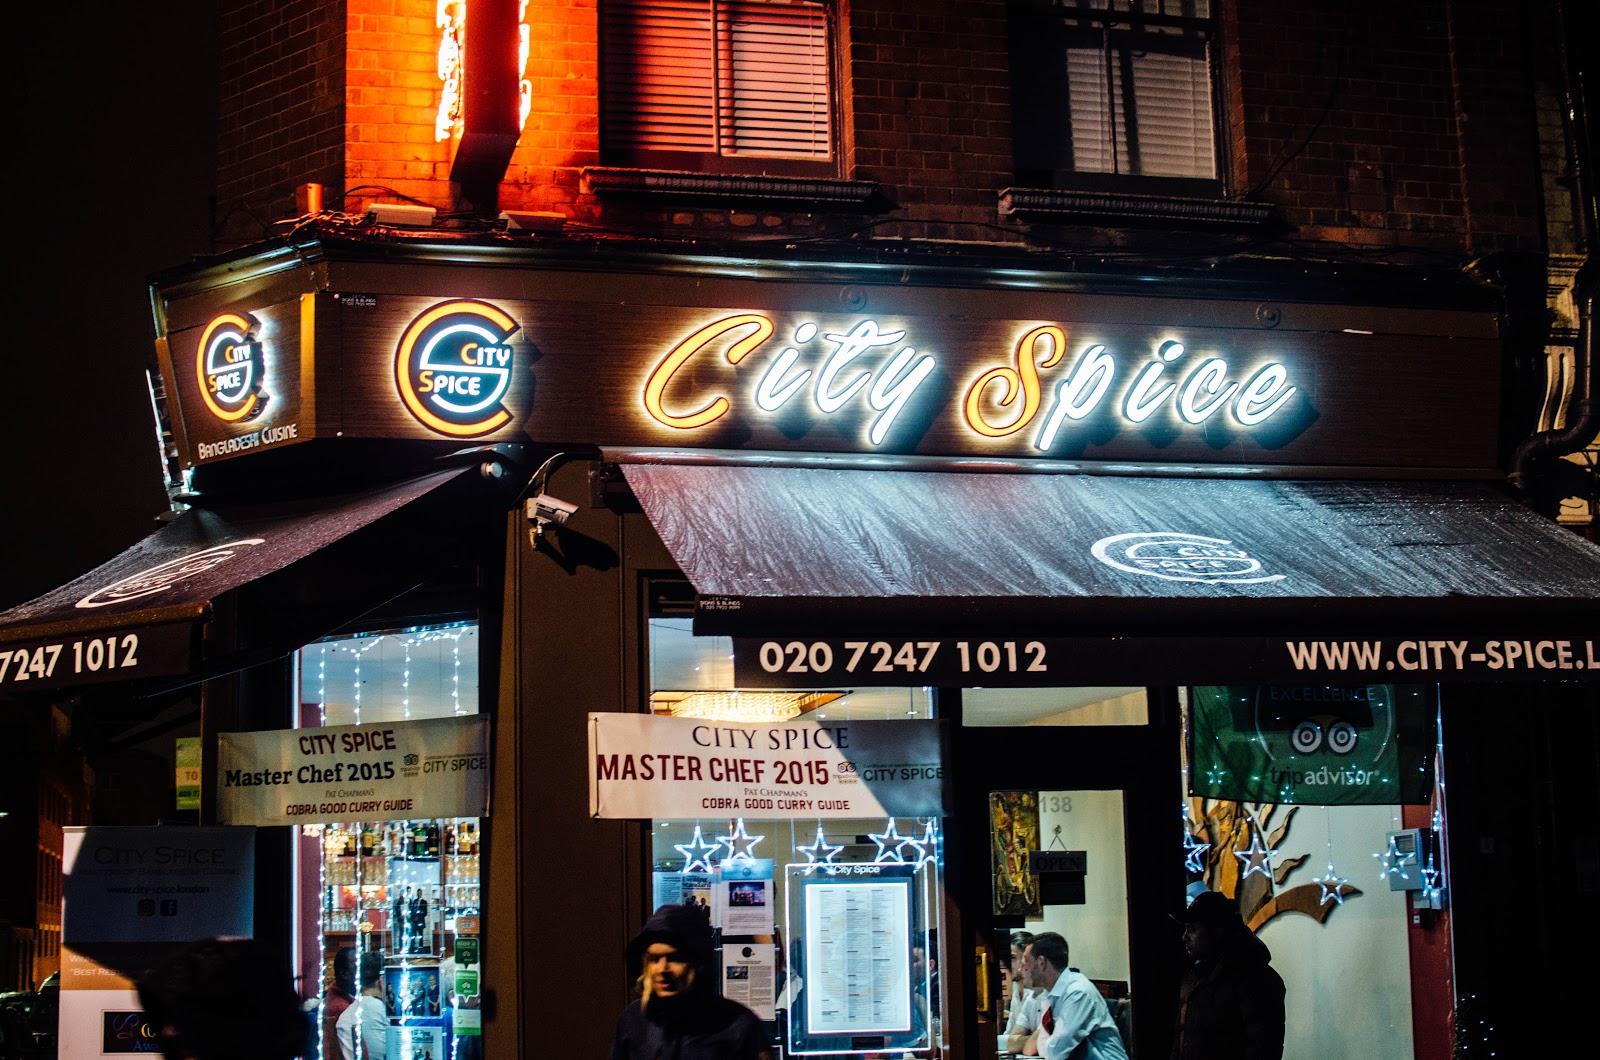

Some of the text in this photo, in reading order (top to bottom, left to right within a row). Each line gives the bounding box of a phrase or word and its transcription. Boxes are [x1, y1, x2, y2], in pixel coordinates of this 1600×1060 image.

[225, 344, 251, 363] CITY
[461, 342, 511, 367] CITY
[208, 371, 242, 393] SPICE
[418, 370, 482, 396] SPICE
[643, 312, 1297, 452] City Spice
[73, 633, 139, 674] 1012
[759, 641, 1048, 673] 020 7247 1012
[1269, 687, 1376, 702] EXCELLENCE
[299, 730, 396, 755] CITY SPICE
[692, 725, 849, 750] CITY SPICE
[225, 762, 395, 788] Master Chef 2015
[423, 757, 487, 774] CITY SPICE
[598, 754, 829, 785] MASTER CHEF 2015
[863, 768, 946, 782] CITY SPICE
[286, 799, 413, 816] COBRA GOOD CURRY GUIDE
[702, 797, 851, 810] COBRA GOOD CURRY GUIDE
[1040, 796, 1072, 813] 138
[834, 865, 881, 876] City Spice
